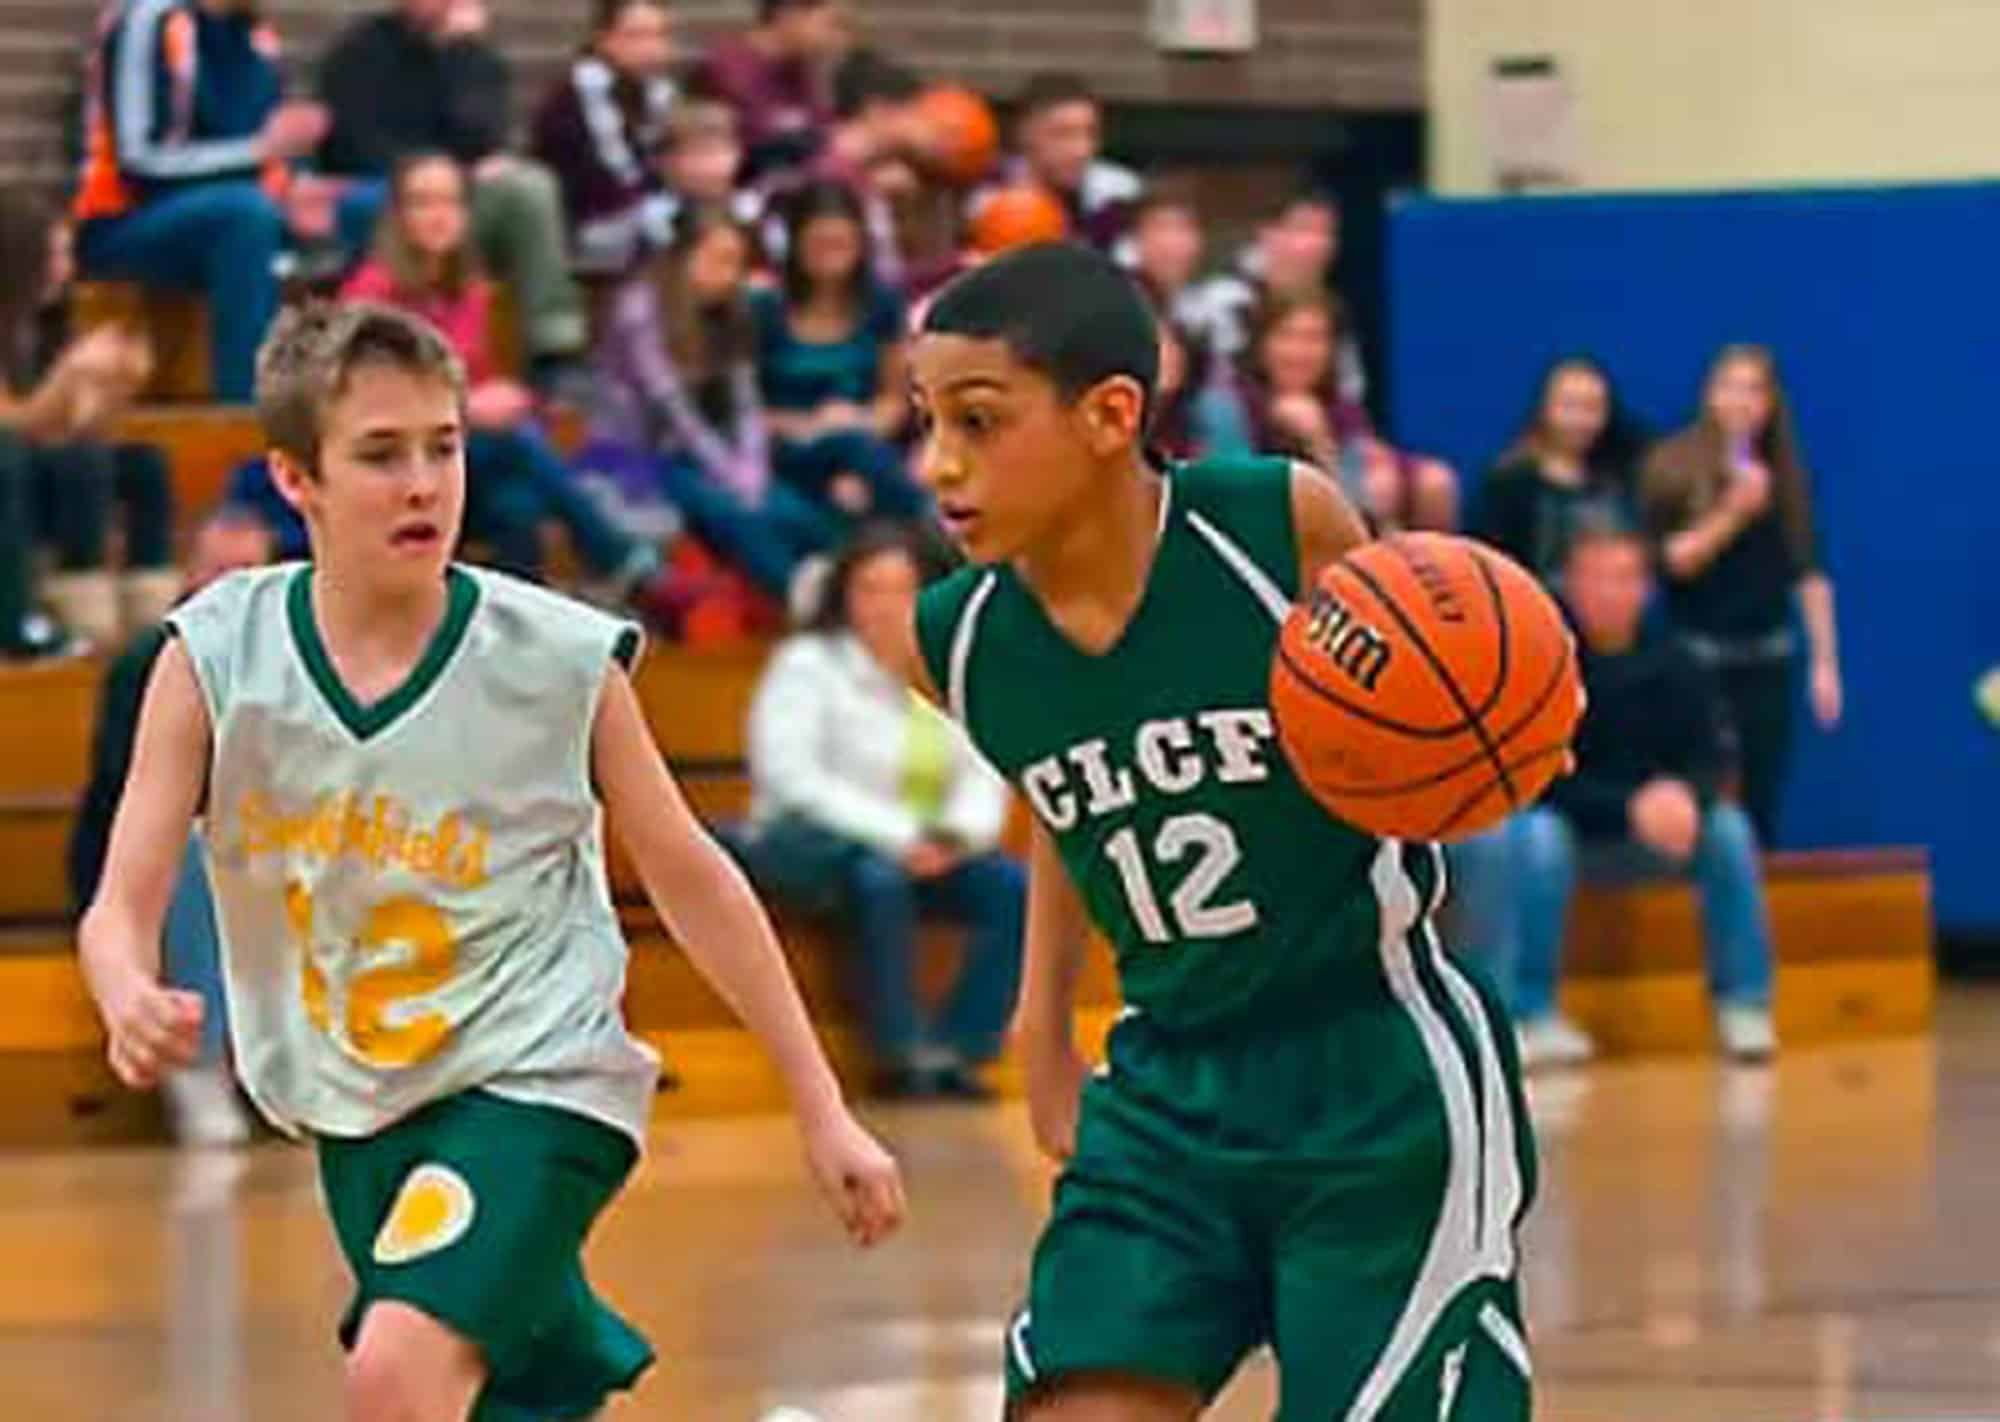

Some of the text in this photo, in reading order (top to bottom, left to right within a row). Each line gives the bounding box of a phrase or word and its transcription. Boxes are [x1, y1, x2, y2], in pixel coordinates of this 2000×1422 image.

[1021, 708, 1273, 830] CLCF
[1103, 812, 1257, 943] 12
[284, 876, 460, 1070] 12
